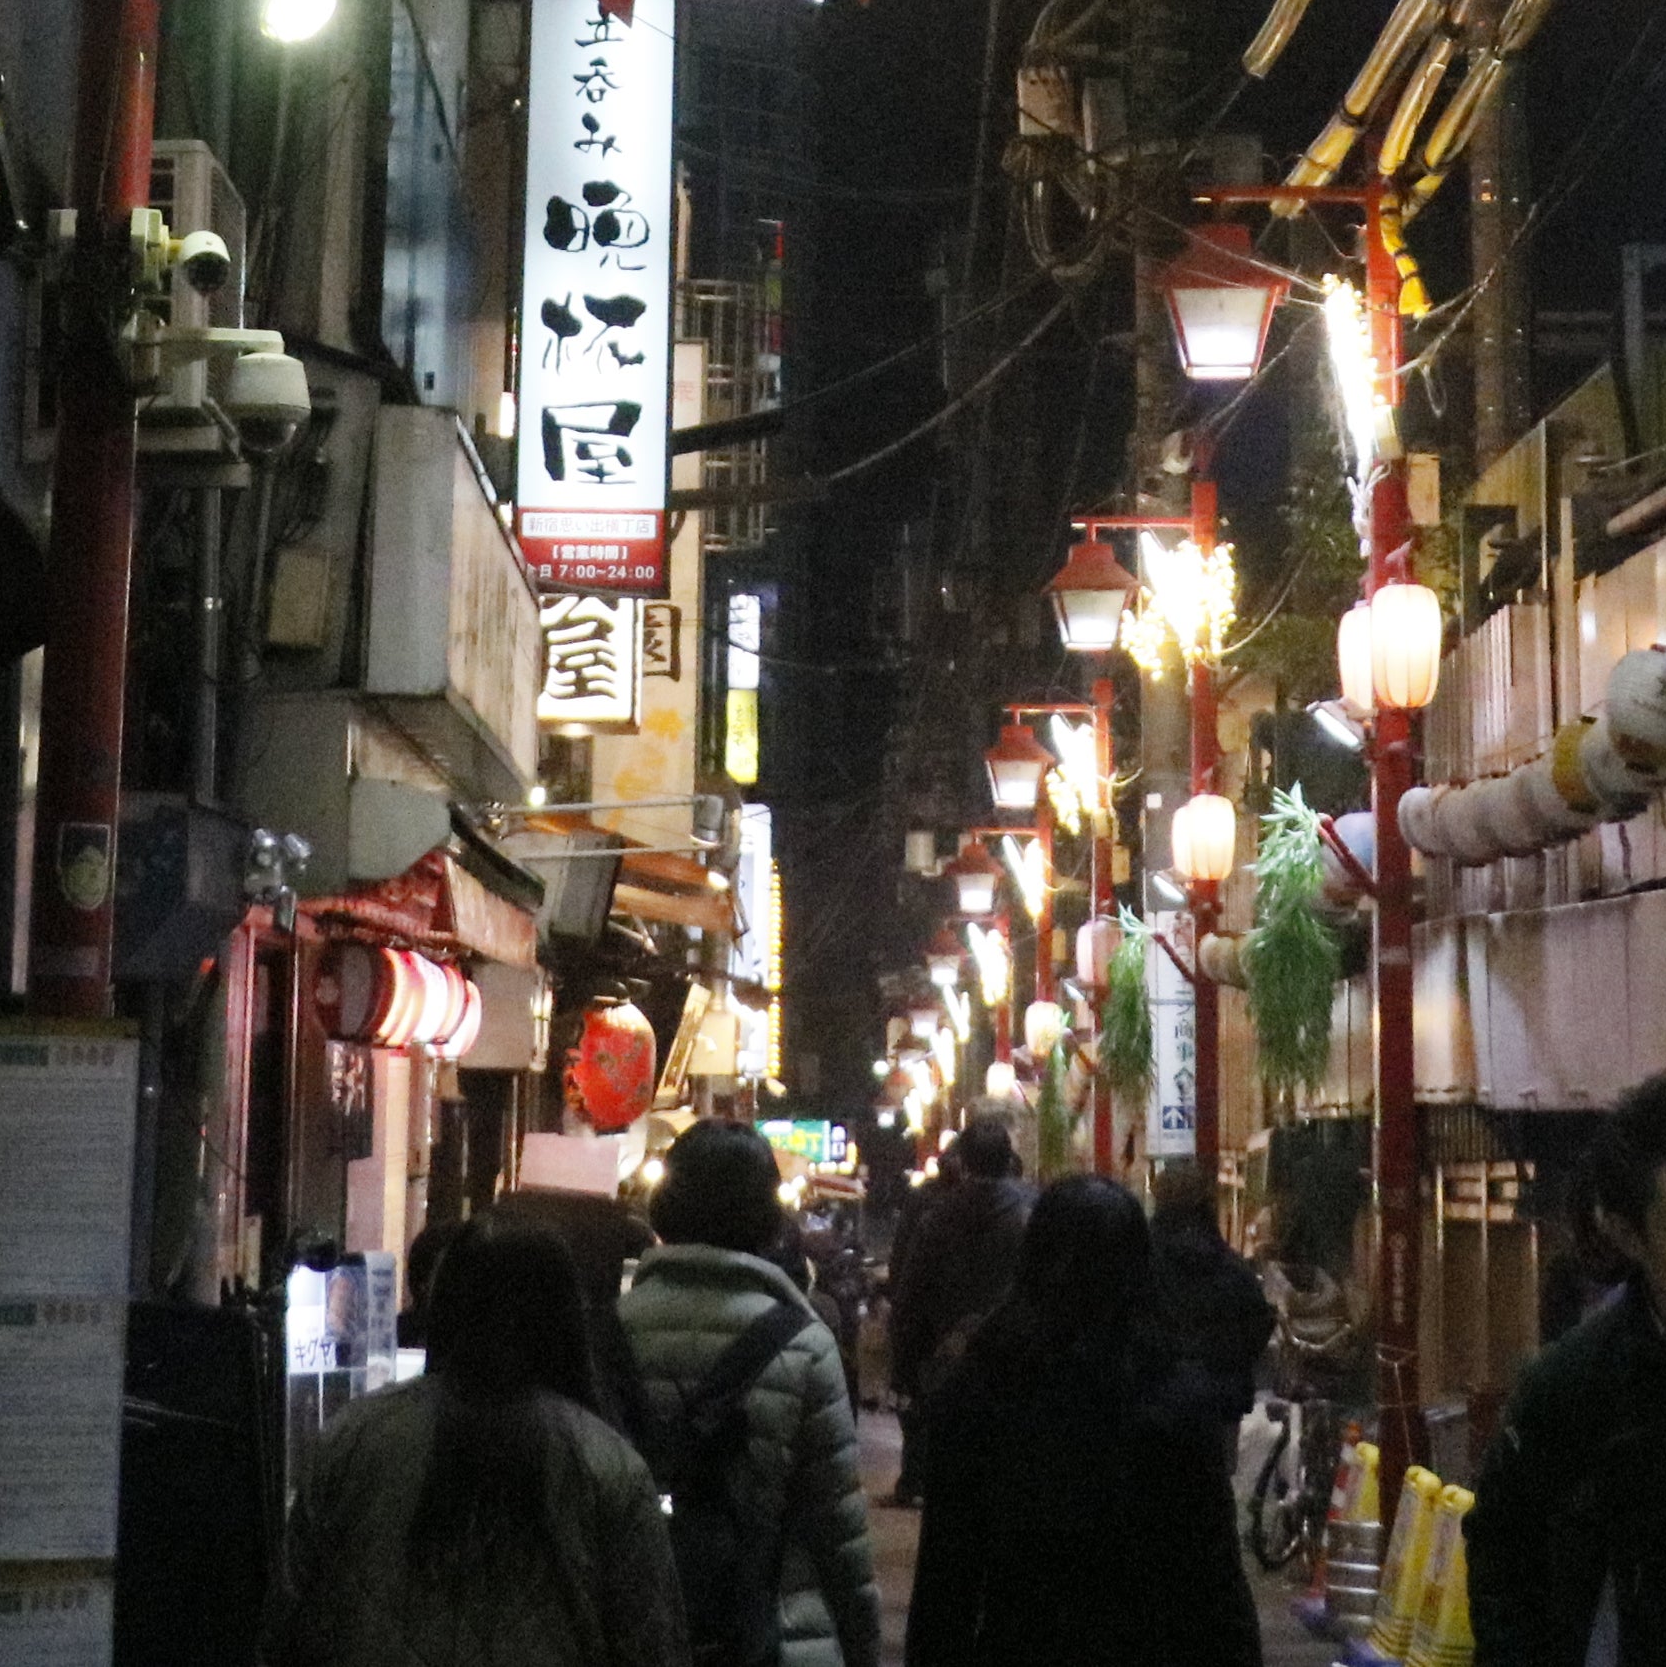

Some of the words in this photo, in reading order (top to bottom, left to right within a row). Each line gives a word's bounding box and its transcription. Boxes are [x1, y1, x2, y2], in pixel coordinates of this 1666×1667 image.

[528, 517, 651, 534] 新宿思い出横丁店
